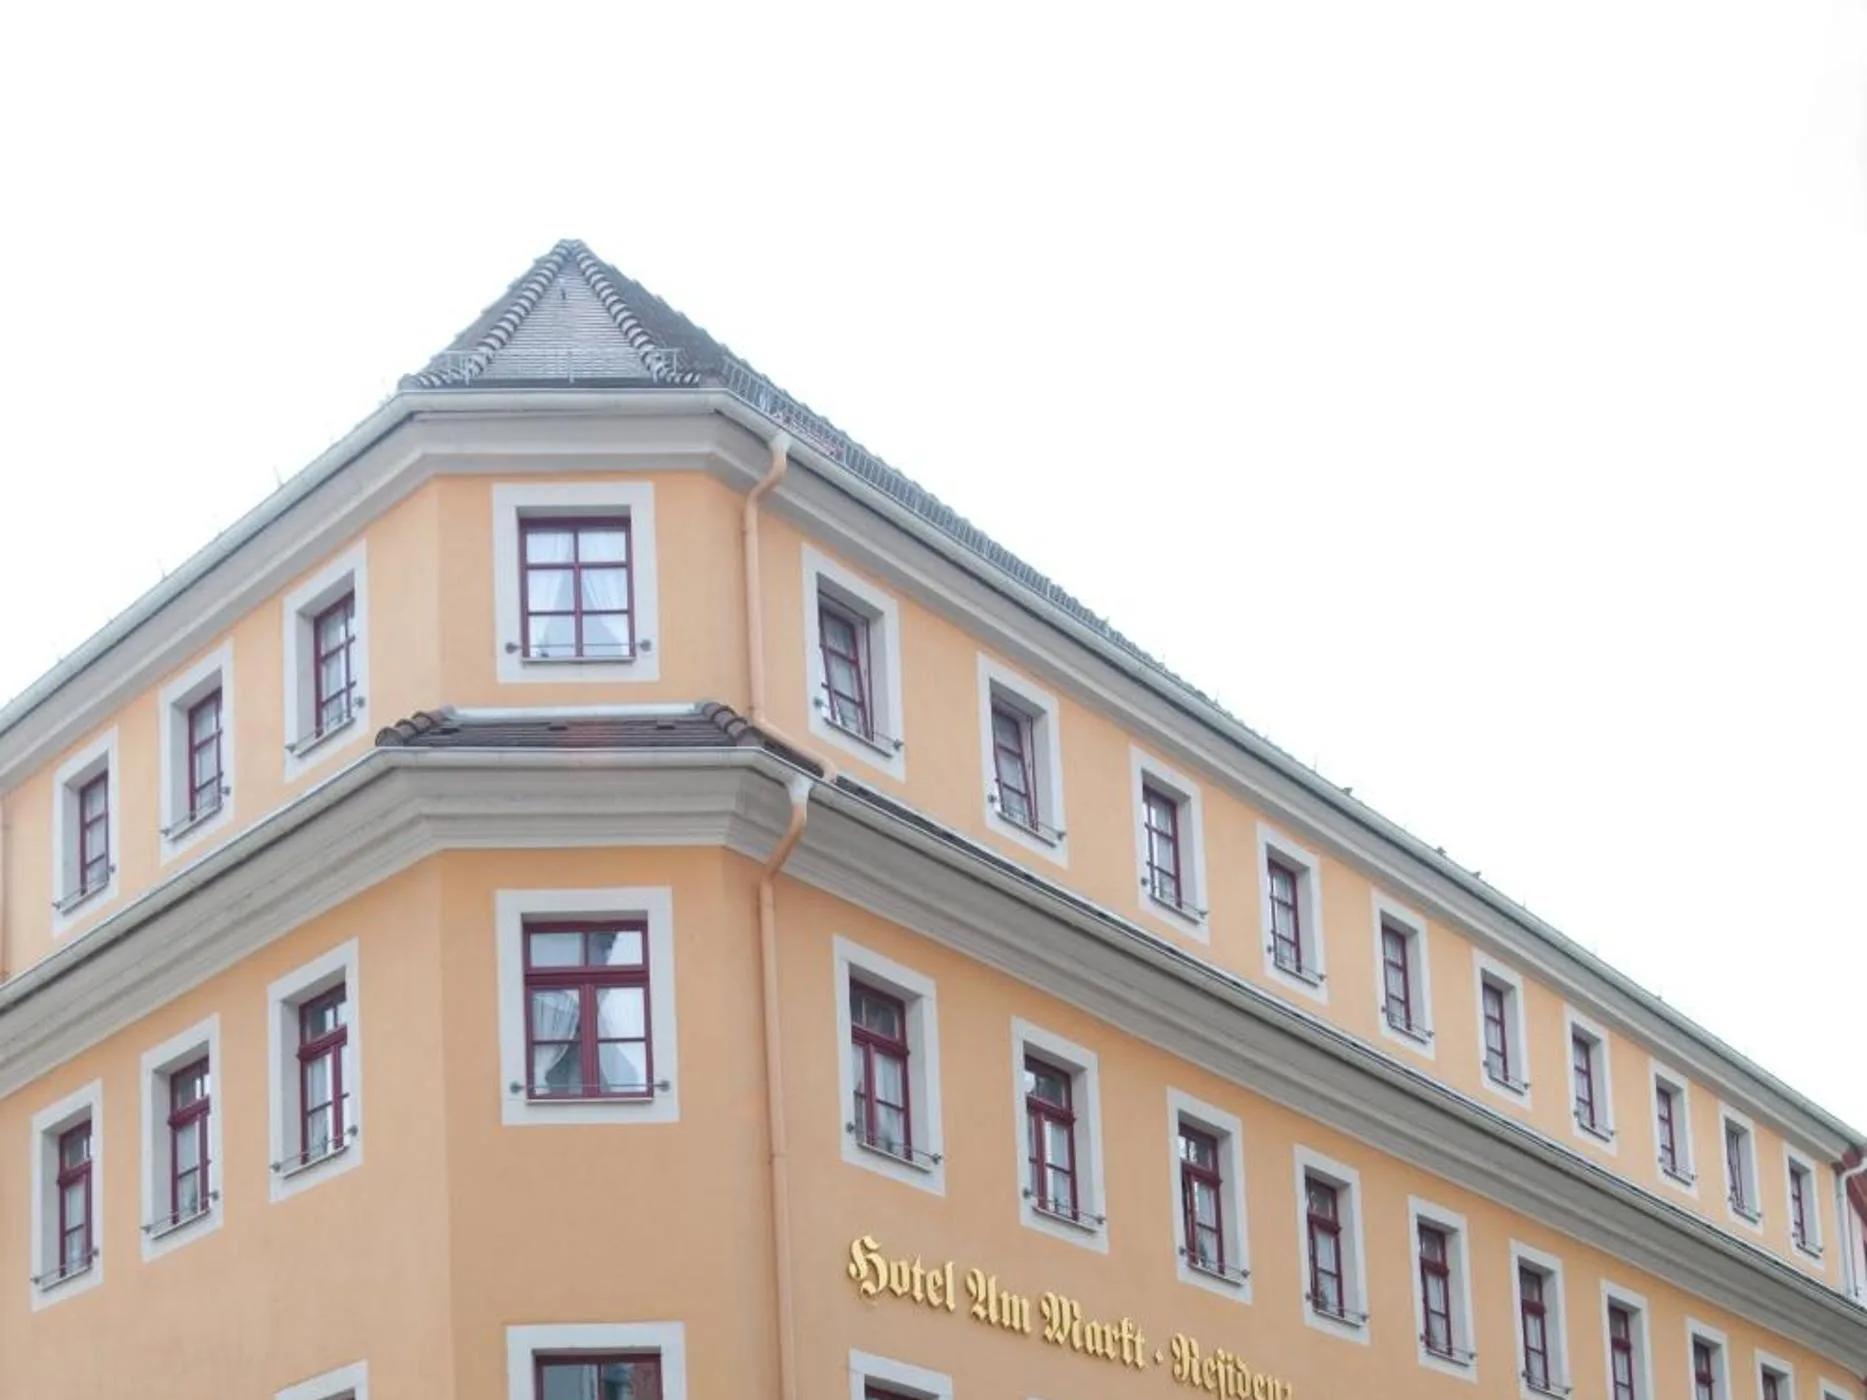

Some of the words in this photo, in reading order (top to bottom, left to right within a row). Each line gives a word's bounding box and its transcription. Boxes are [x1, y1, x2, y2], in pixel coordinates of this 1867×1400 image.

[847, 1235, 956, 1312] Hotel
[965, 1267, 1032, 1335] Am
[1040, 1291, 1146, 1369] Markt
